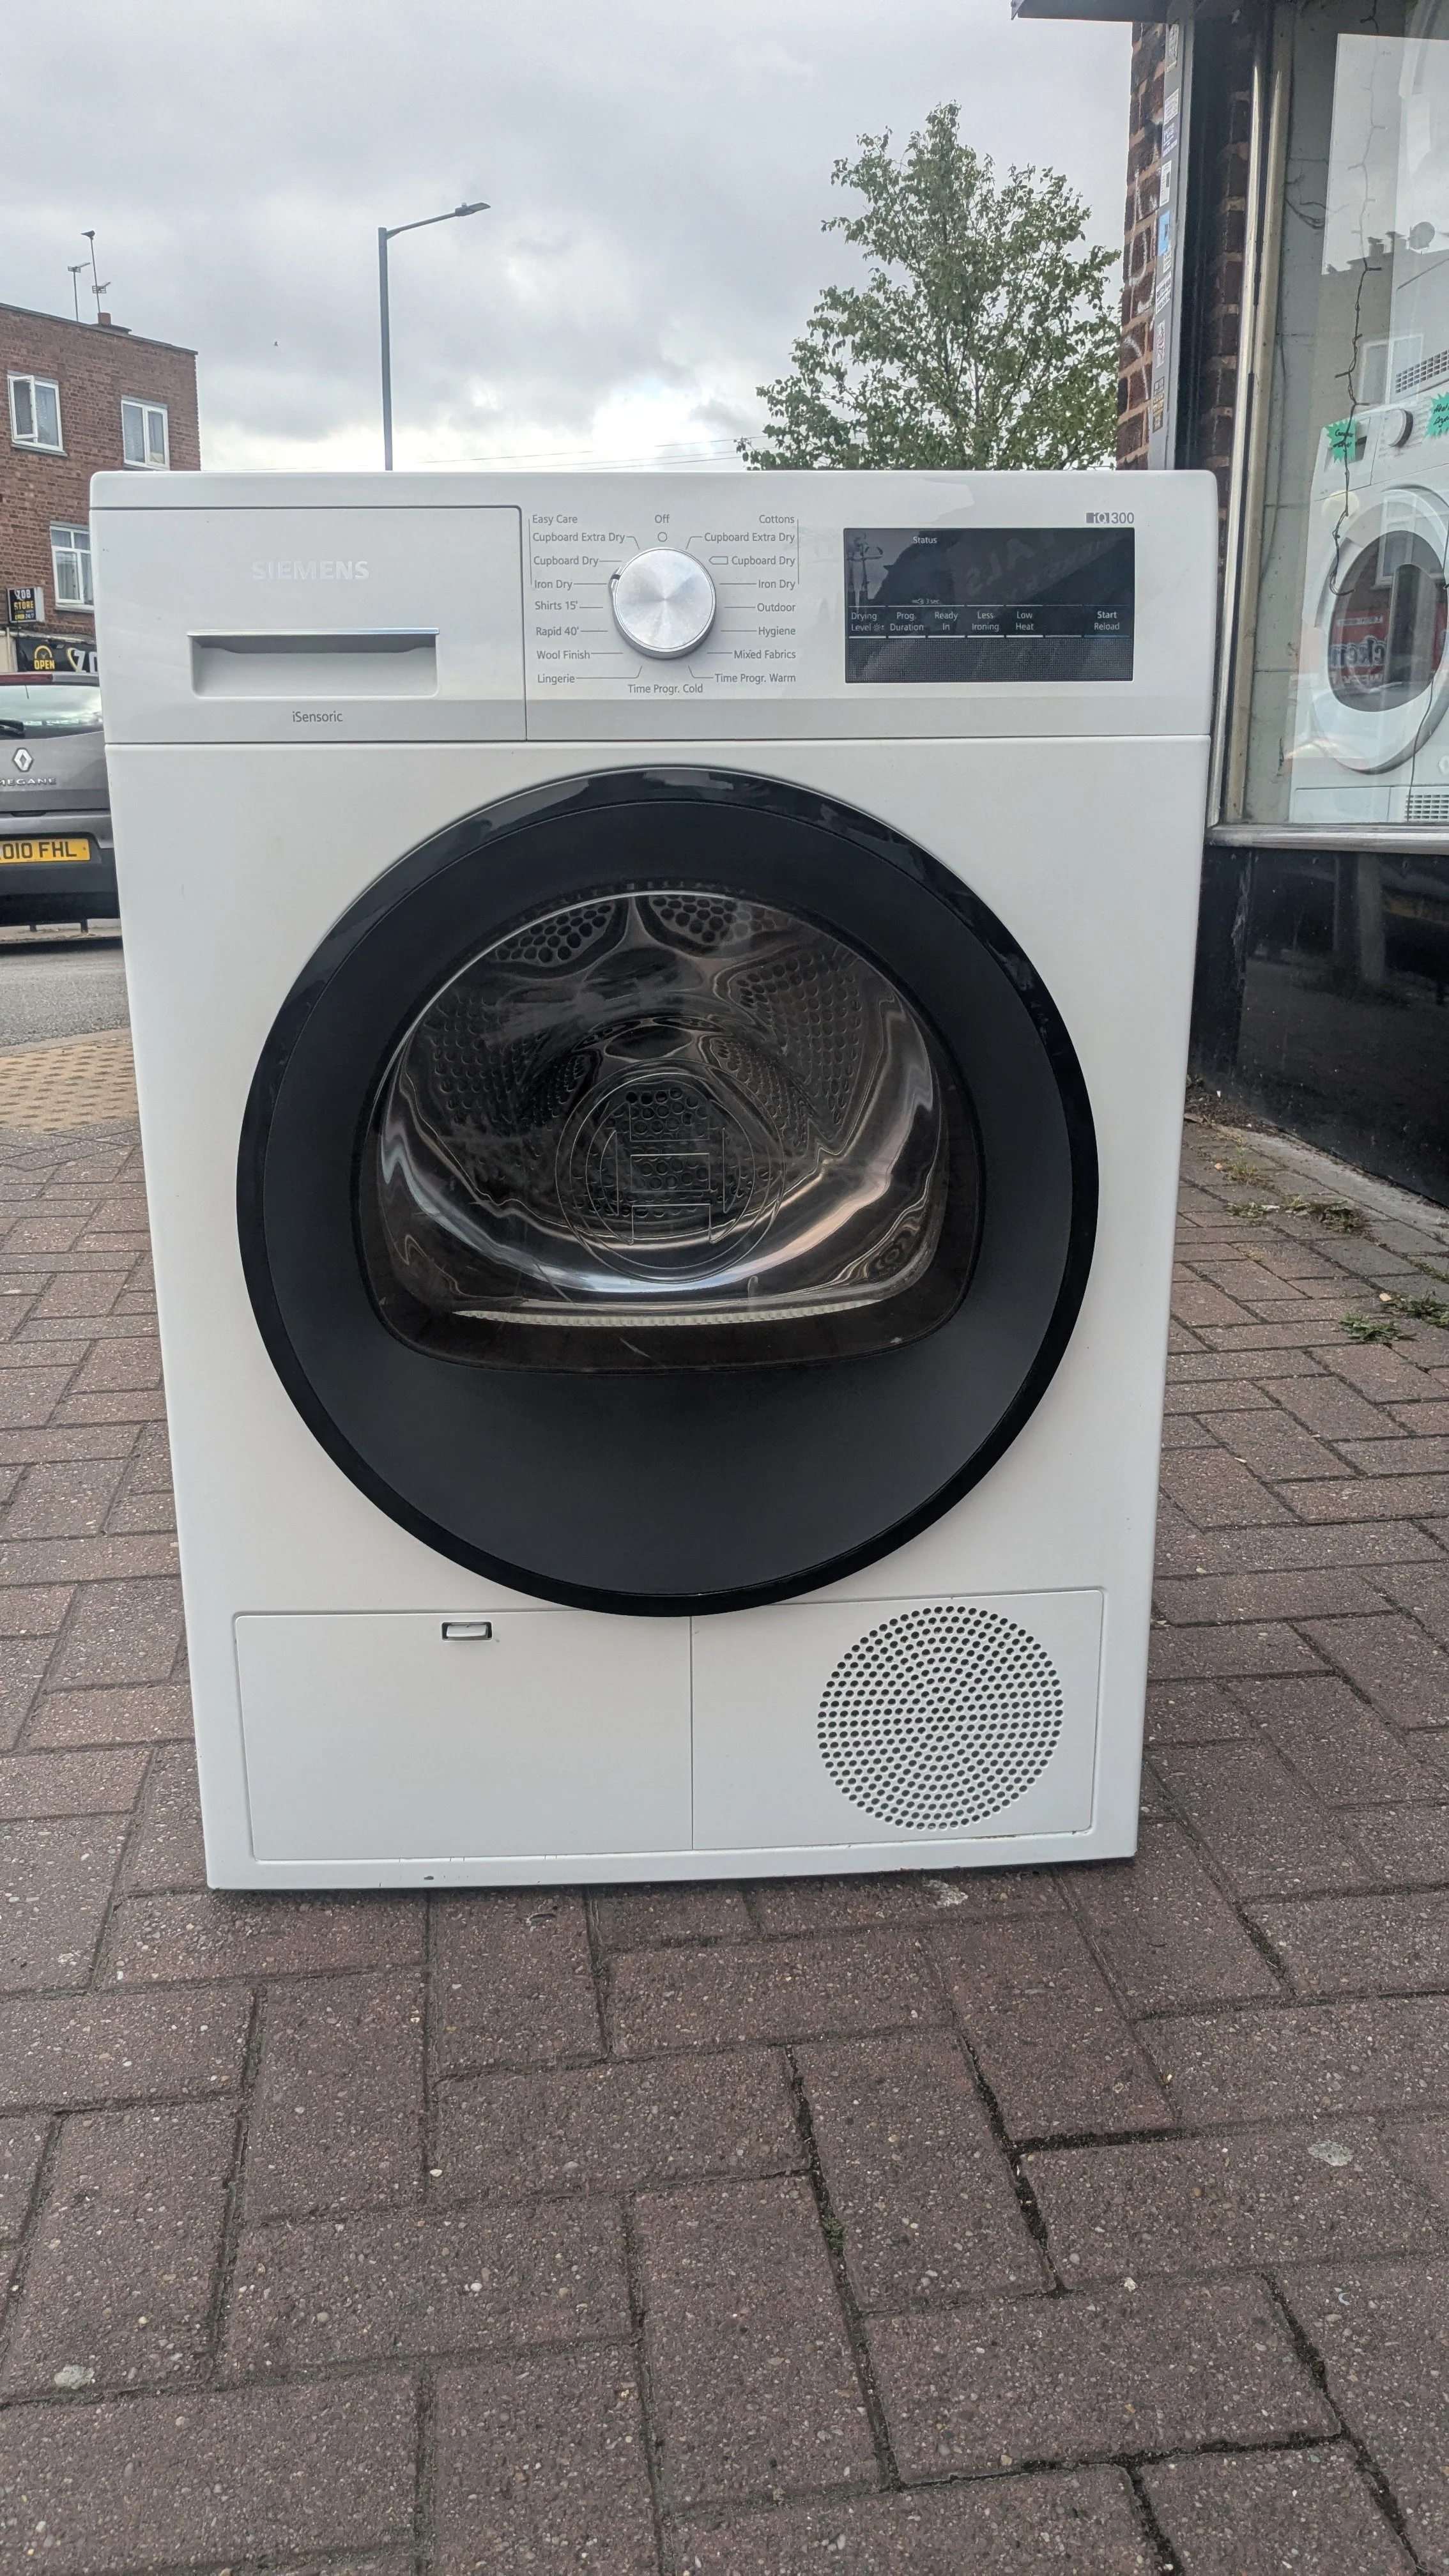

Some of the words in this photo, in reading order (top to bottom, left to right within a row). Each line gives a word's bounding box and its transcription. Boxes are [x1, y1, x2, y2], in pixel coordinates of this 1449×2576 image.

[533, 514, 553, 525] Easy
[558, 515, 578, 524] Care
[655, 514, 670, 523] Off
[759, 515, 794, 523] Cottons
[533, 532, 578, 543] Cupboard
[582, 533, 605, 541] Extra
[609, 533, 625, 544] Dry
[705, 532, 749, 544] Cupboard
[753, 533, 776, 541] Extra
[779, 533, 795, 544] Dry
[912, 535, 937, 544] Status
[533, 556, 579, 567] Cupboard
[583, 556, 600, 567] Dry
[732, 556, 776, 567] Cupboard
[779, 556, 795, 567] Dry
[252, 561, 369, 580] SIEMENS
[535, 580, 553, 588] Iron
[556, 580, 572, 591] Dry
[759, 579, 776, 588] Iron
[779, 579, 795, 590] Dry
[14, 601, 34, 610] STORE
[535, 601, 562, 610] Shirts
[758, 603, 795, 611] Outdoor
[852, 611, 877, 621] Drying
[935, 611, 958, 621] Ready
[536, 627, 561, 638] Rapid
[759, 626, 795, 638] Hygiene
[972, 623, 999, 632] Ironing
[537, 650, 560, 659] Wool
[565, 650, 590, 659] Finish
[734, 650, 761, 659] Mixed
[765, 650, 795, 659] Fabrics
[34, 659, 56, 670] OPEN
[538, 674, 575, 685] Lingerie
[715, 673, 737, 682] Time
[740, 674, 766, 685] Progr.
[769, 673, 795, 682] Warm
[628, 684, 650, 693] Time
[654, 684, 679, 695] Progr.
[683, 684, 703, 693] Cold
[293, 710, 342, 722] iSensoric
[38, 841, 77, 858] FHL
